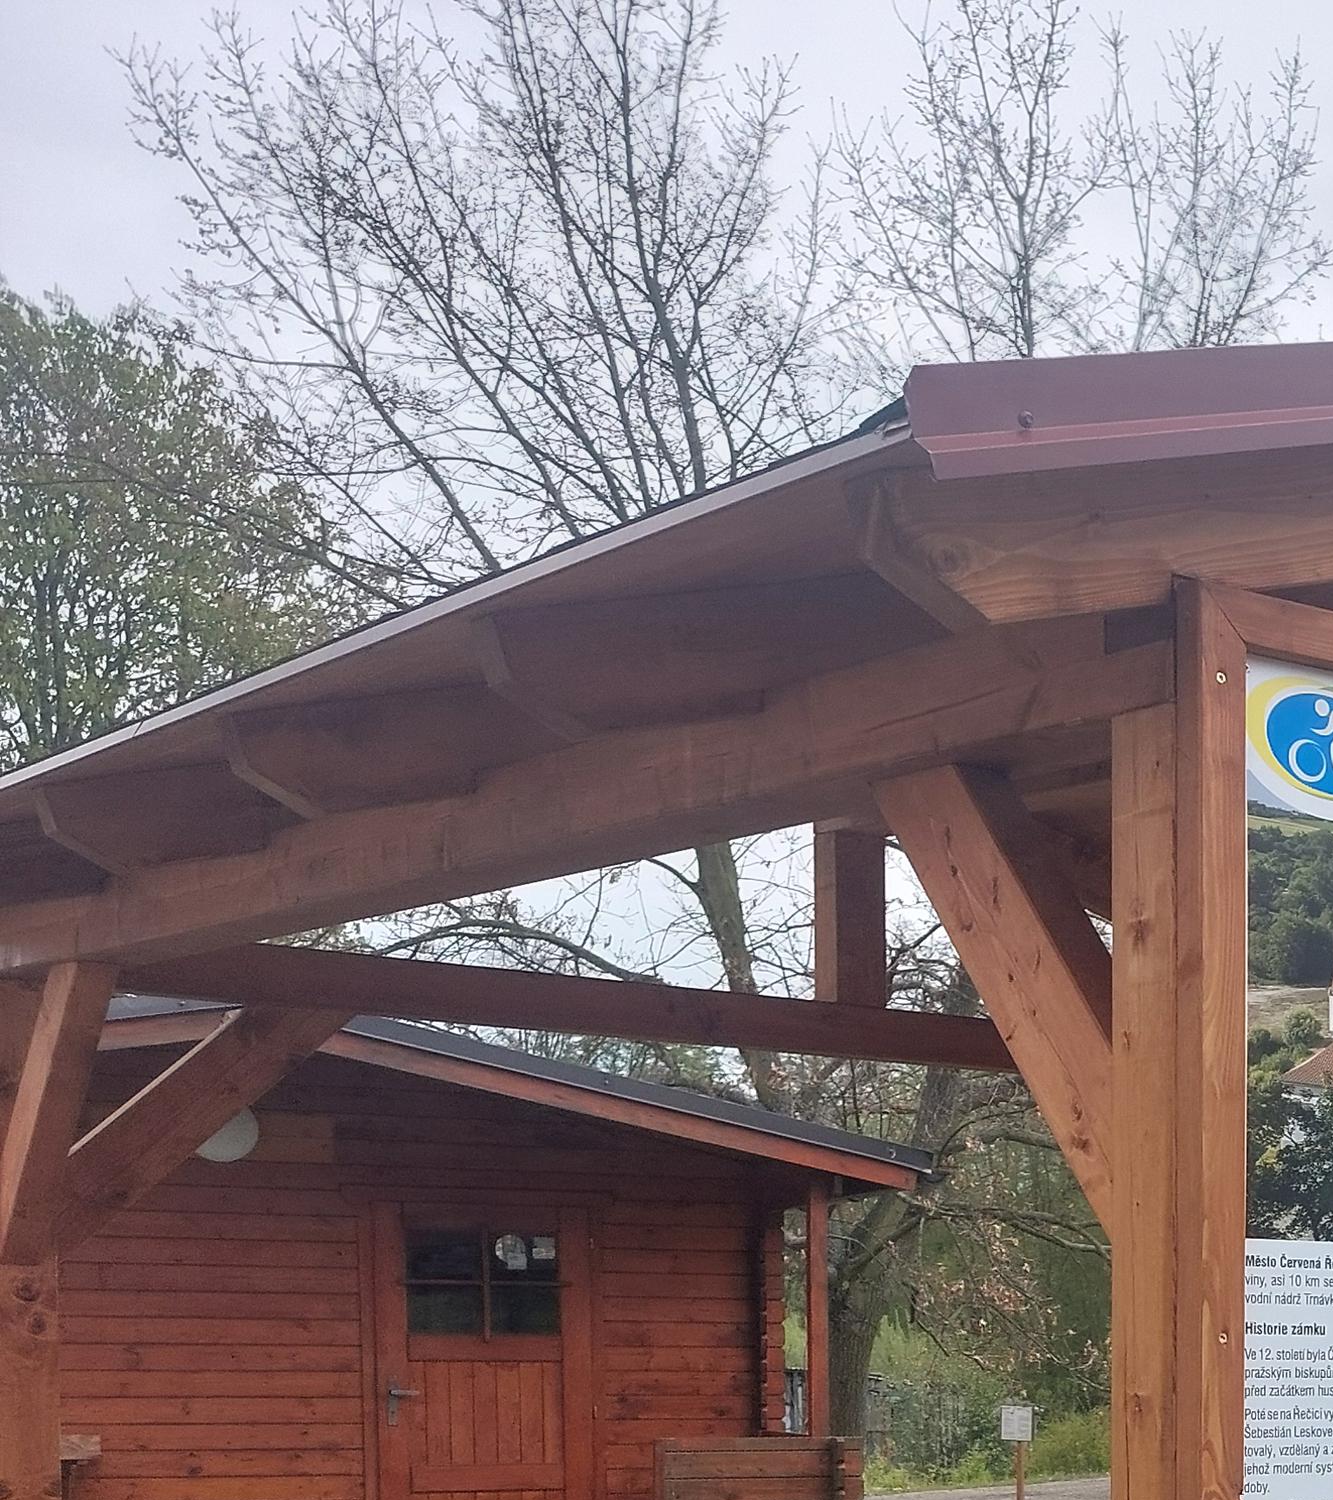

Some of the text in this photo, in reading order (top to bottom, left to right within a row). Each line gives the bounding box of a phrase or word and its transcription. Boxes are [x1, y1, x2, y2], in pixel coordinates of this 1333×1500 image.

[1245, 1255, 1276, 1268] Město
[1280, 1254, 1321, 1269] Červená
[1245, 1274, 1267, 1288] viny,
[1270, 1275, 1284, 1286] asi
[1288, 1275, 1301, 1286] 10
[1304, 1276, 1320, 1287] km
[1245, 1293, 1271, 1304] vodní
[1274, 1293, 1300, 1305] nádrž
[1245, 1323, 1325, 1335] Historie zámku
[1245, 1350, 1256, 1361] Ve
[1258, 1350, 1274, 1361] 12.
[1276, 1349, 1304, 1361] století
[1306, 1350, 1325, 1363] byla
[1245, 1366, 1291, 1380] pražským
[1245, 1384, 1266, 1398] před
[1268, 1384, 1314, 1396] začátkem
[1245, 1407, 1266, 1419] Poté
[1292, 1405, 1322, 1419] Řečici
[1244, 1424, 1291, 1438] Šebestián
[1244, 1444, 1276, 1458] tovalý,
[1279, 1443, 1320, 1457] vzdělaný
[1244, 1462, 1269, 1476] jehož
[1272, 1461, 1313, 1474] moderní
[1244, 1482, 1270, 1496] doby.
